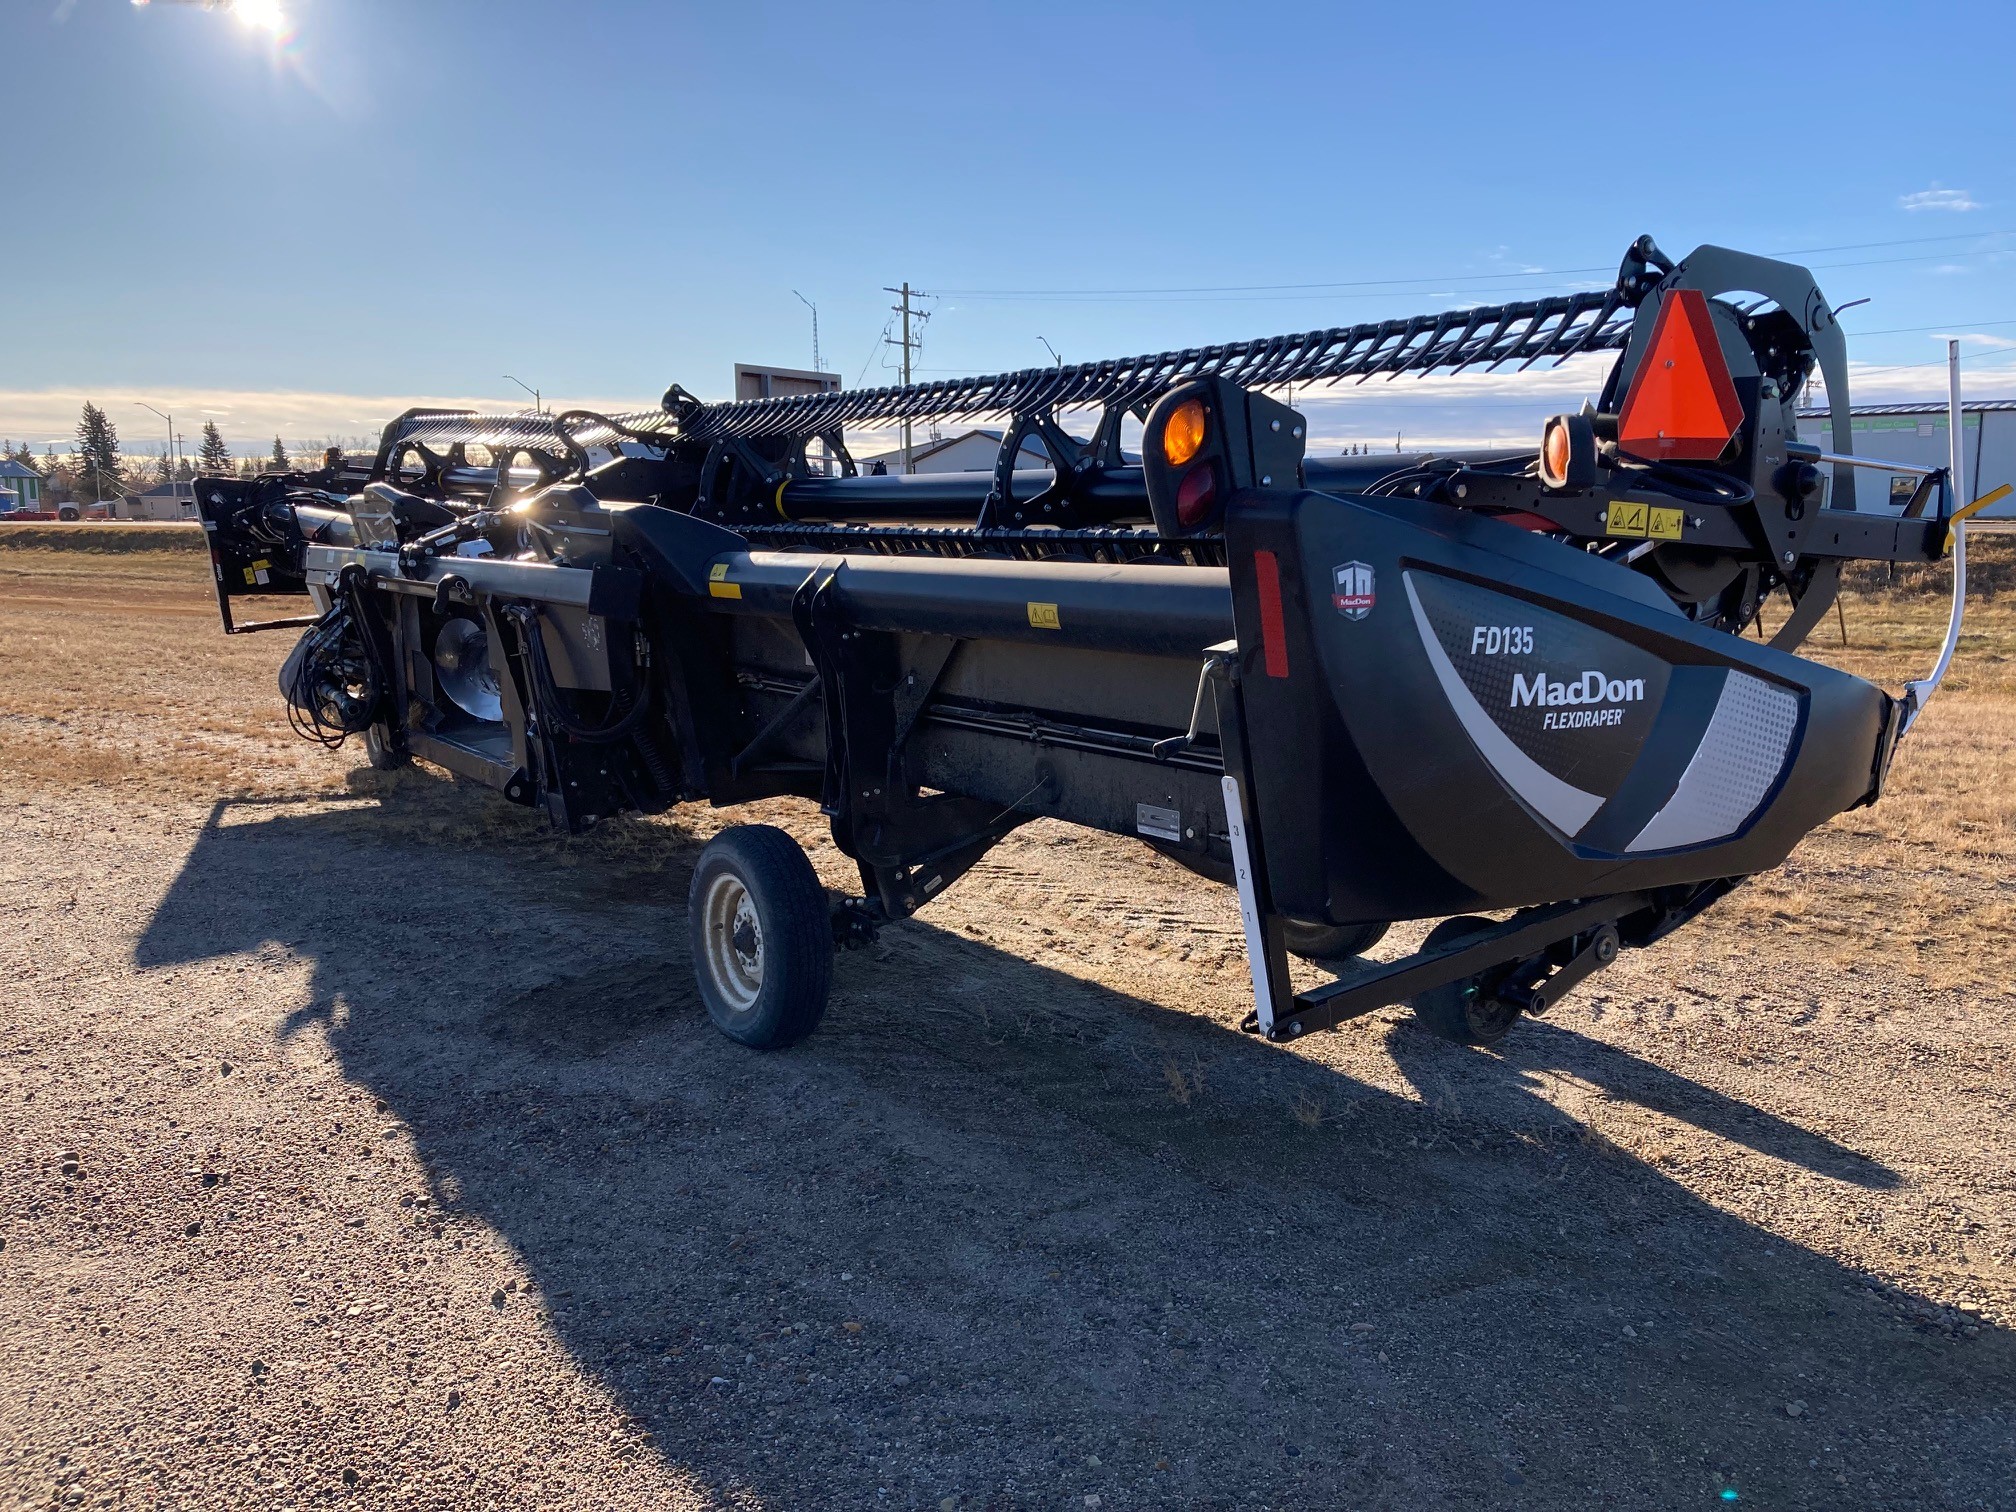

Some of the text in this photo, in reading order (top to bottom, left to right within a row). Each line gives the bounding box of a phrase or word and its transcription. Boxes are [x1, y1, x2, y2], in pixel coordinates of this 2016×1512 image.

[1340, 597, 1371, 606] MacDon
[1470, 626, 1534, 655] FD135
[1510, 670, 1644, 708] MacDon
[1543, 708, 1624, 730] FLEXDRAPER
[1233, 825, 1240, 836] 3
[1239, 868, 1246, 880] 2
[1246, 911, 1251, 922] 1
